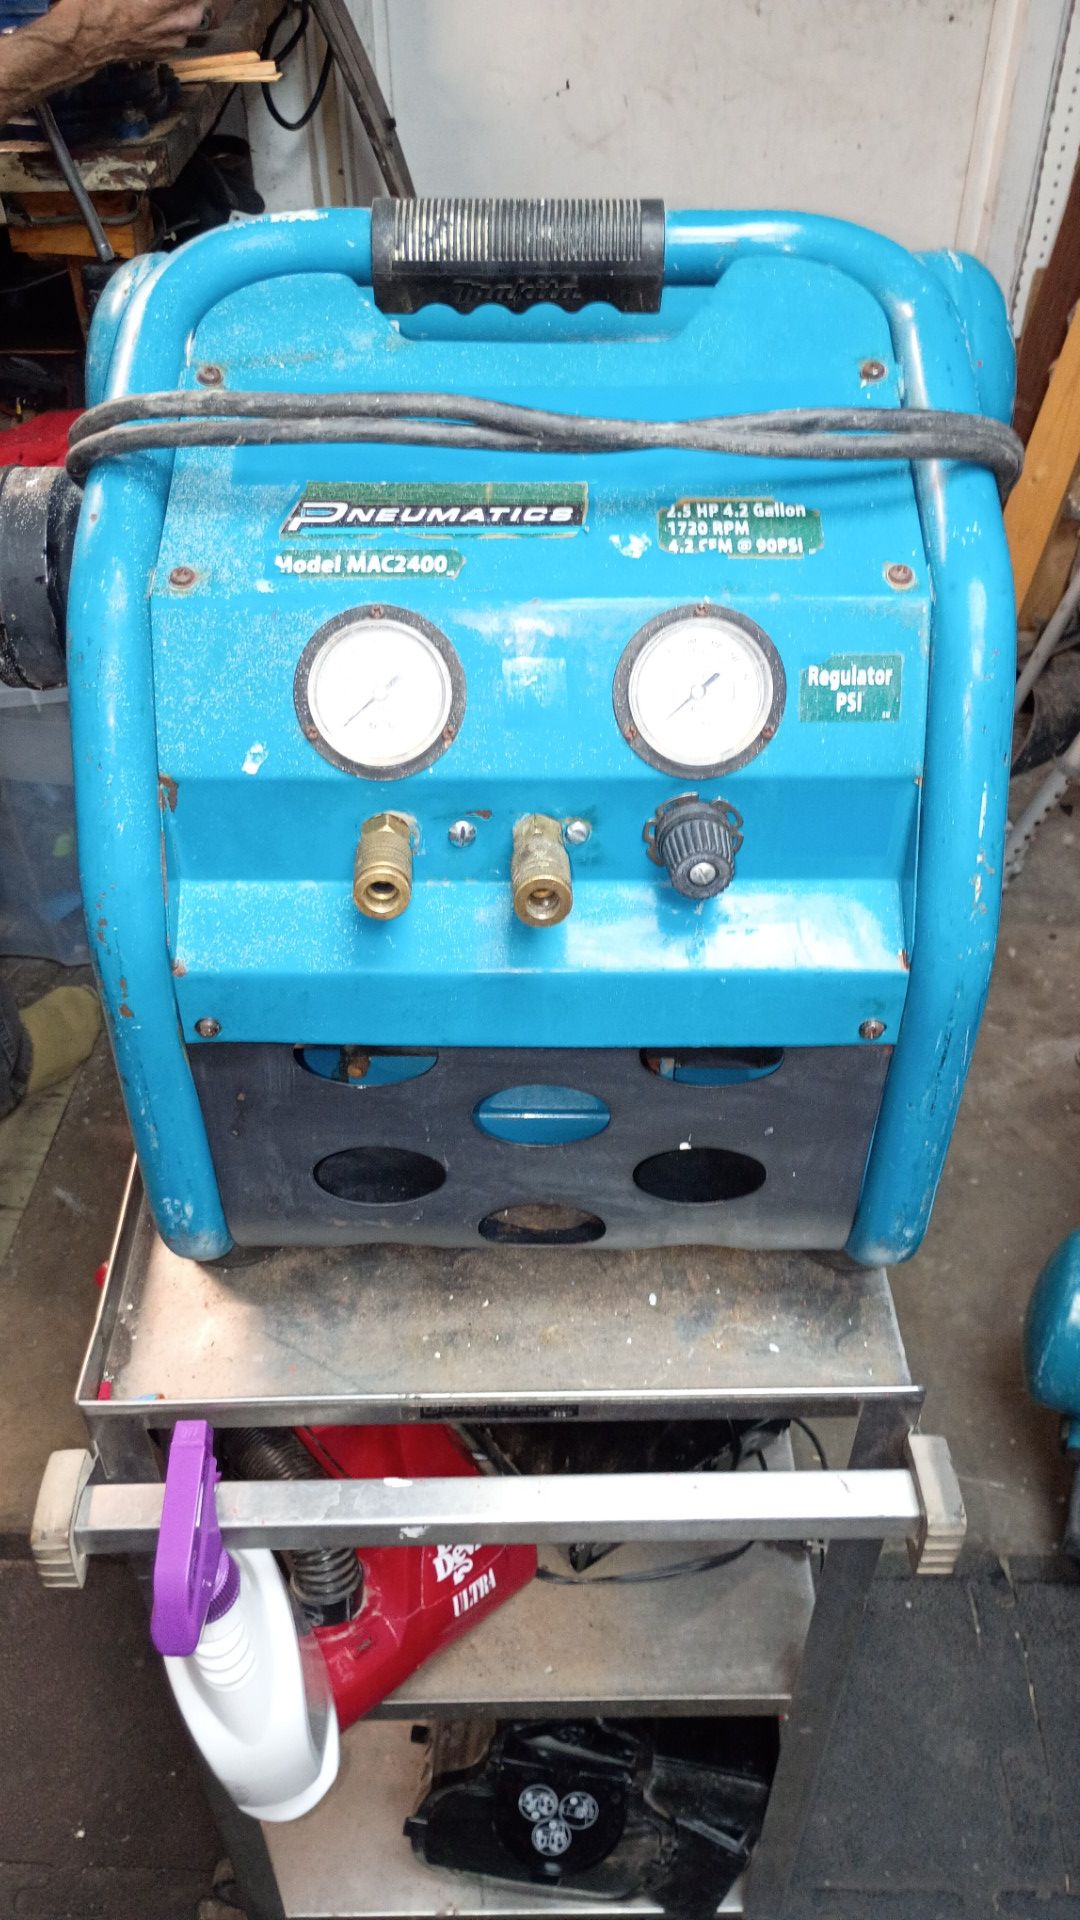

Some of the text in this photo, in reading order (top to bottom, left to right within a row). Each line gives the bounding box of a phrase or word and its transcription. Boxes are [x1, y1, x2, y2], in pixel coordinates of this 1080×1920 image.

[667, 501, 806, 518] 2.5 HP 4.2 Gallon
[667, 520, 750, 536] 1720 RPM
[668, 538, 694, 554] 4.2
[737, 537, 752, 553] @
[756, 537, 804, 553] 90PSI
[275, 554, 448, 574] Model MAC2400
[808, 664, 893, 691] Regulator
[836, 691, 863, 713] PSI
[452, 1567, 497, 1617] ULTRA
